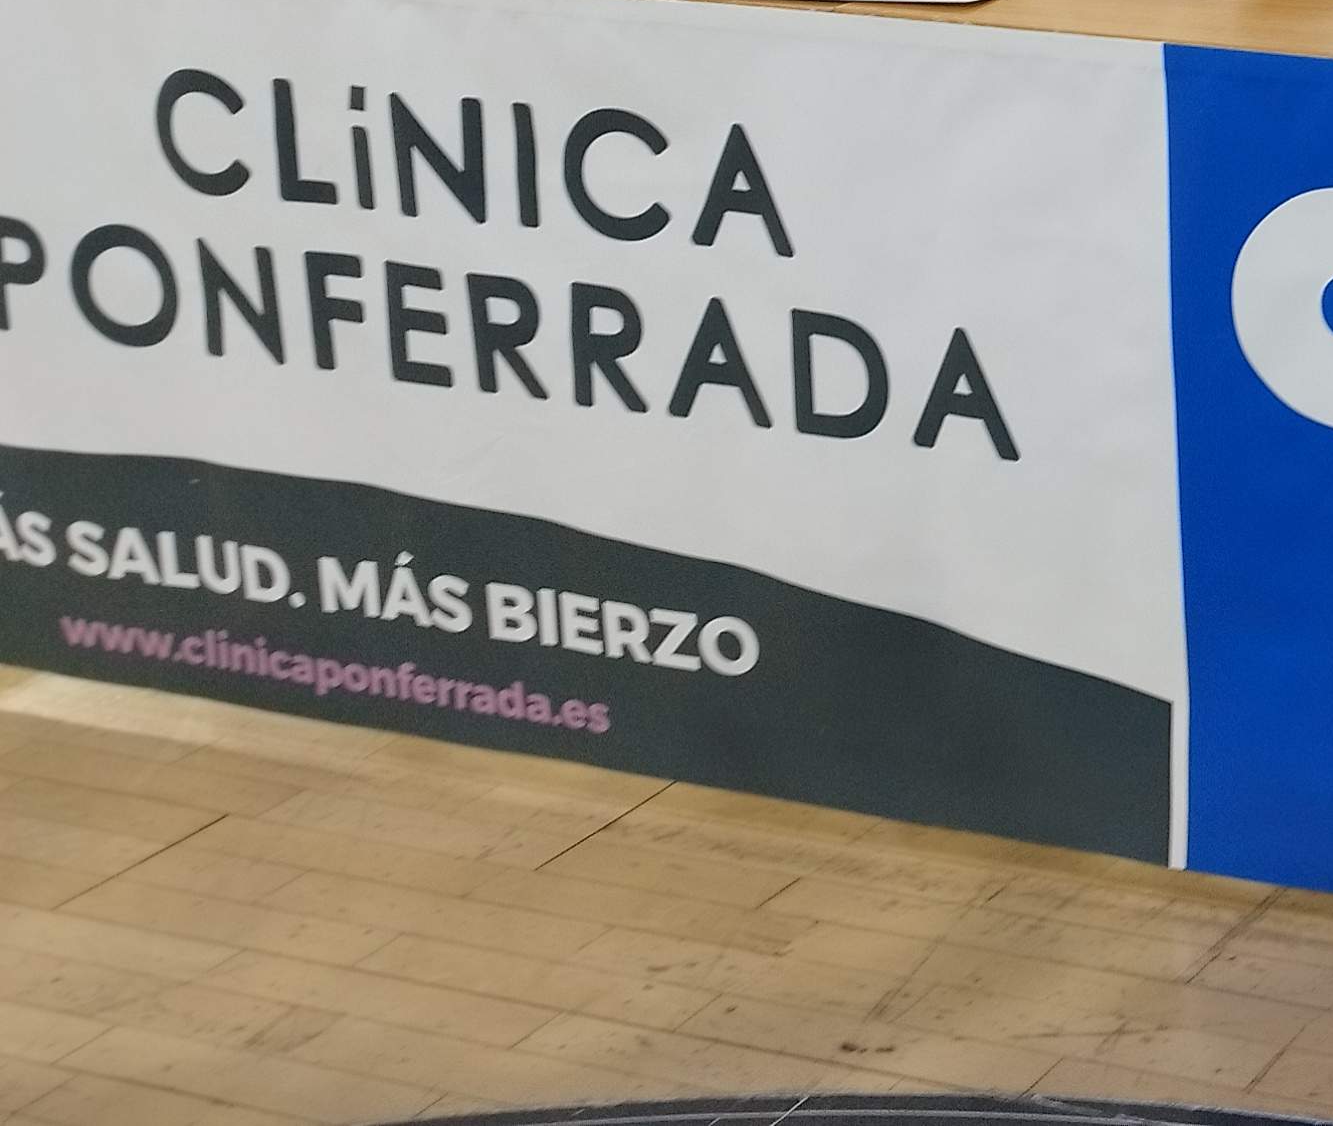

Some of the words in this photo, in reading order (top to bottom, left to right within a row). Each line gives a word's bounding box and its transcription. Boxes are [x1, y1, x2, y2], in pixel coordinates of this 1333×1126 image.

[0, 212, 1020, 463] PONFERRADA
[59, 608, 612, 735] www.clinicaponferrada.es
[66, 519, 307, 609] SALUD.
[320, 549, 475, 634] MÁS
[488, 580, 762, 677] BIERZO
